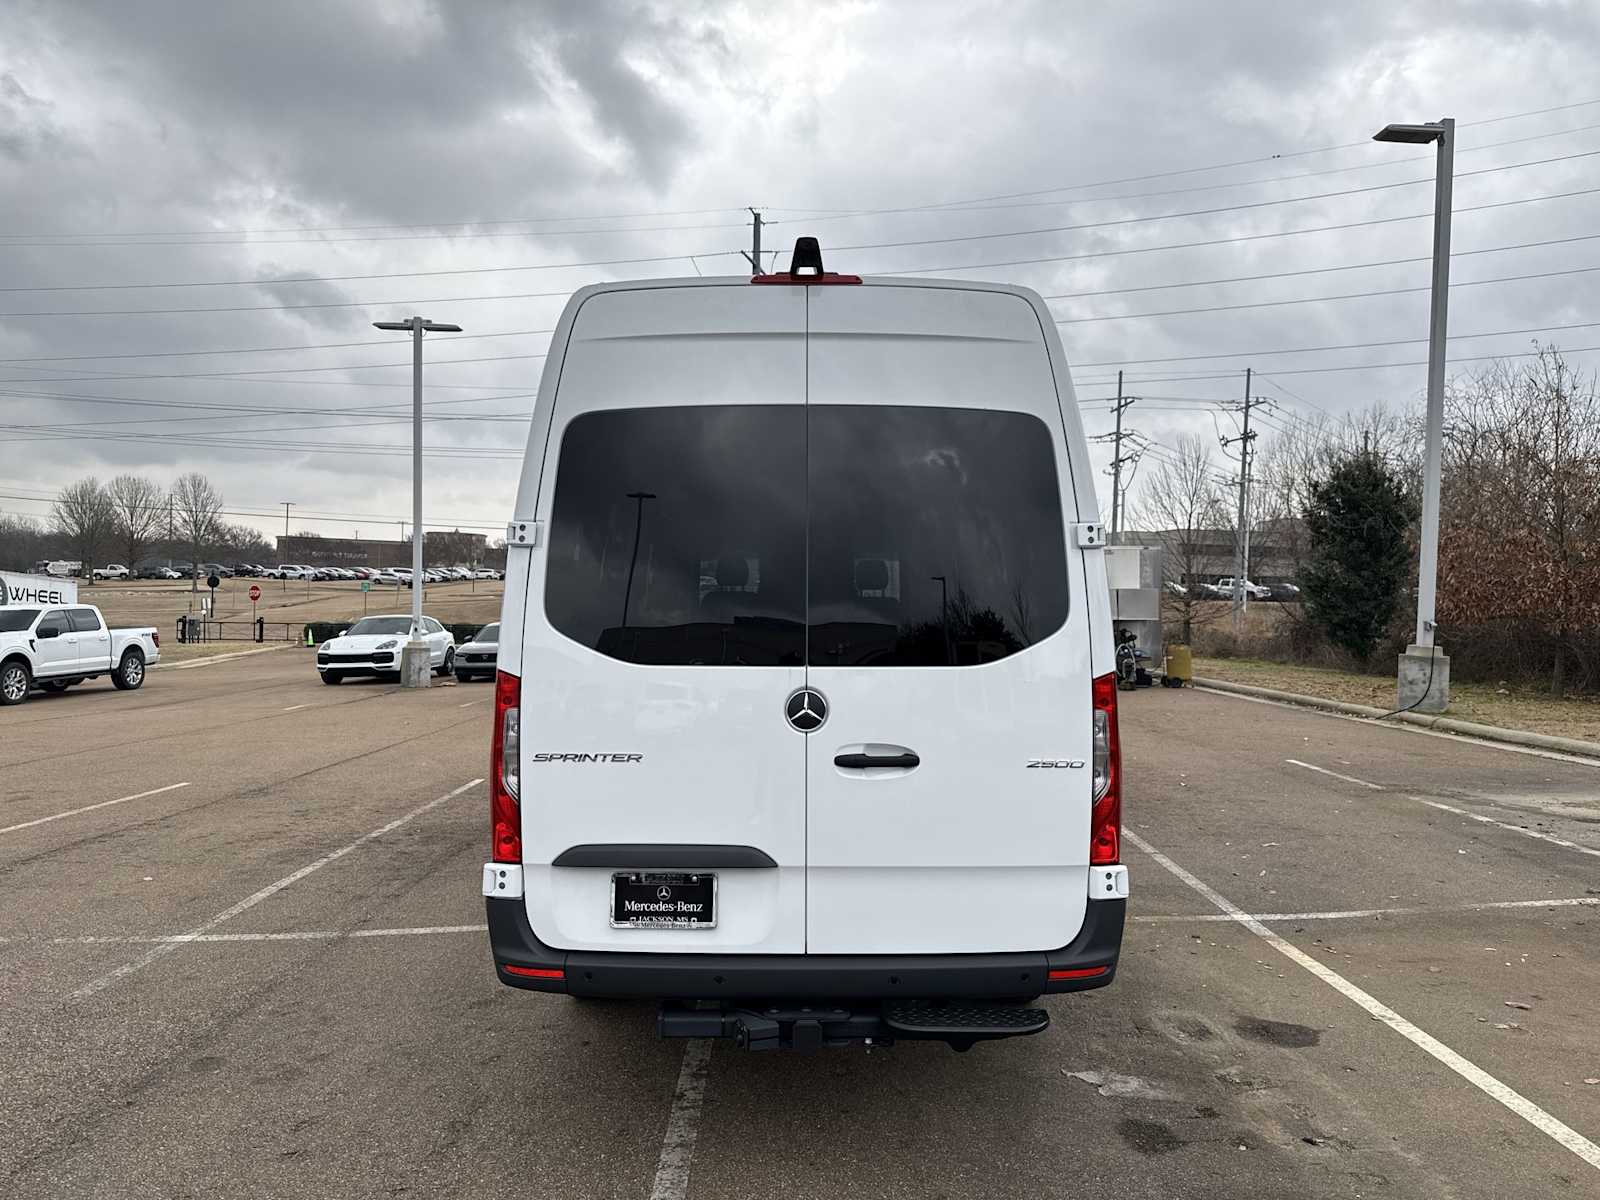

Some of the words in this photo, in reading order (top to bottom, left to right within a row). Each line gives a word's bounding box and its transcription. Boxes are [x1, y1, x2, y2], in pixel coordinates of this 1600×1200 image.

[9, 586, 68, 604] WHEEL
[533, 753, 643, 762] SPRINTER
[1026, 760, 1085, 768] 2500
[624, 900, 703, 912] Mercedes-Benz
